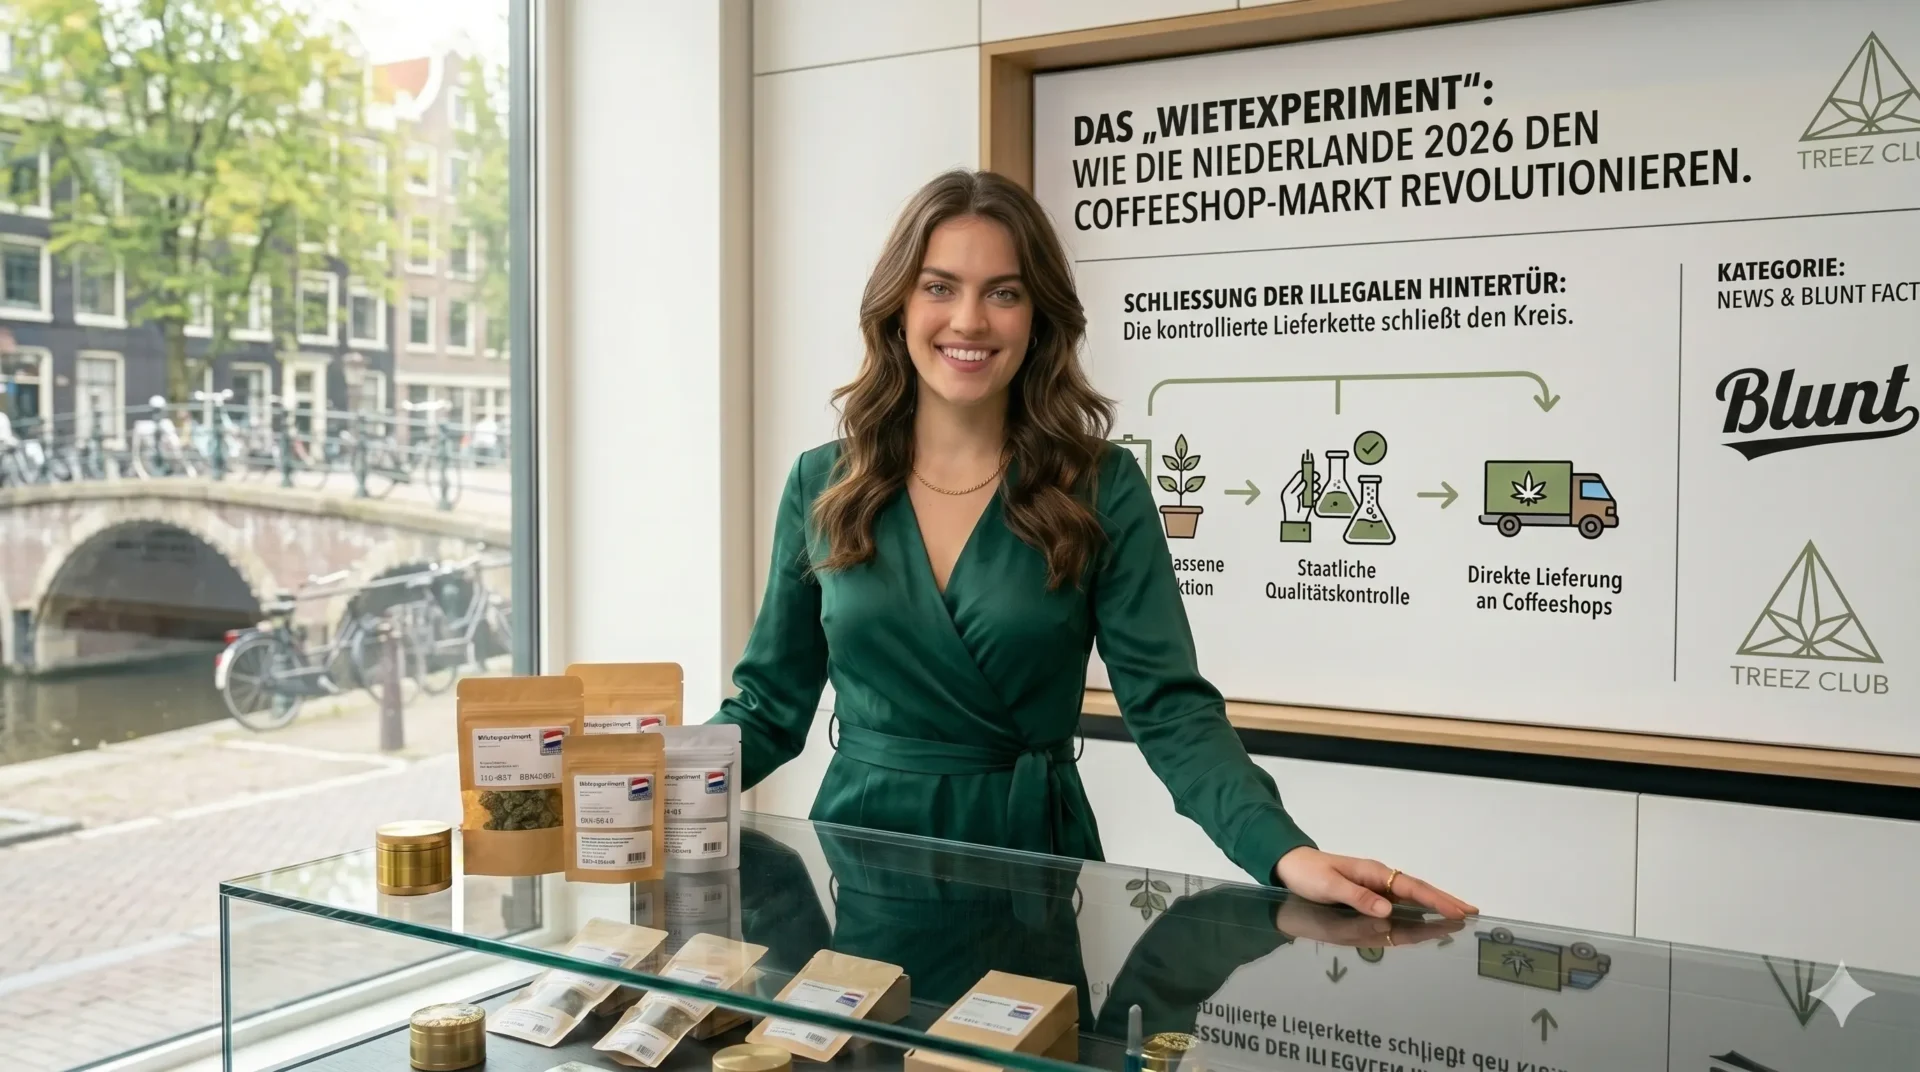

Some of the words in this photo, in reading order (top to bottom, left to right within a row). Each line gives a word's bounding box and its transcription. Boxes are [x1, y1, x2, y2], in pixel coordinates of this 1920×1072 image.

[1074, 110, 1134, 146] DAS
[1073, 154, 1127, 188] WIE
[1136, 149, 1183, 183] DIE
[1193, 127, 1414, 179] NIEDERLANDE
[1424, 118, 1514, 159] 2026
[1526, 109, 1599, 150] DEN
[1796, 145, 1875, 170] TREEZ
[1074, 176, 1393, 232] COFFEESHOP-MARKT
[1401, 147, 1752, 208] REVOLUTIONIEREN.
[1717, 257, 1846, 283] KATEGORIE:
[1123, 287, 1258, 314] SCHLIESSUNG
[1263, 284, 1304, 306] DER
[1309, 278, 1422, 304] ILLEGALEN
[1429, 266, 1567, 300] HINTERTÜR:
[1717, 288, 1775, 310] NEWS
[1780, 287, 1795, 307] &
[1801, 284, 1867, 306] BLUNT
[1123, 320, 1152, 341] Die
[1156, 315, 1269, 340] kontrollierte
[1273, 311, 1376, 336] Lieferkette
[1381, 306, 1462, 332] schließt
[1467, 304, 1506, 329] den
[1513, 304, 1574, 327] Kreis.
[1715, 364, 1919, 447] Blunt
[1297, 558, 1377, 580] Staatliche
[1468, 565, 1531, 587] Direkte
[1536, 567, 1623, 595] Lieferung
[1265, 582, 1411, 606] Qualitätskontrolle
[1476, 595, 1498, 610] an
[1502, 592, 1613, 621] Coffeeshops
[1730, 665, 1811, 690] TREEZ
[1818, 671, 1890, 695] CLUB
